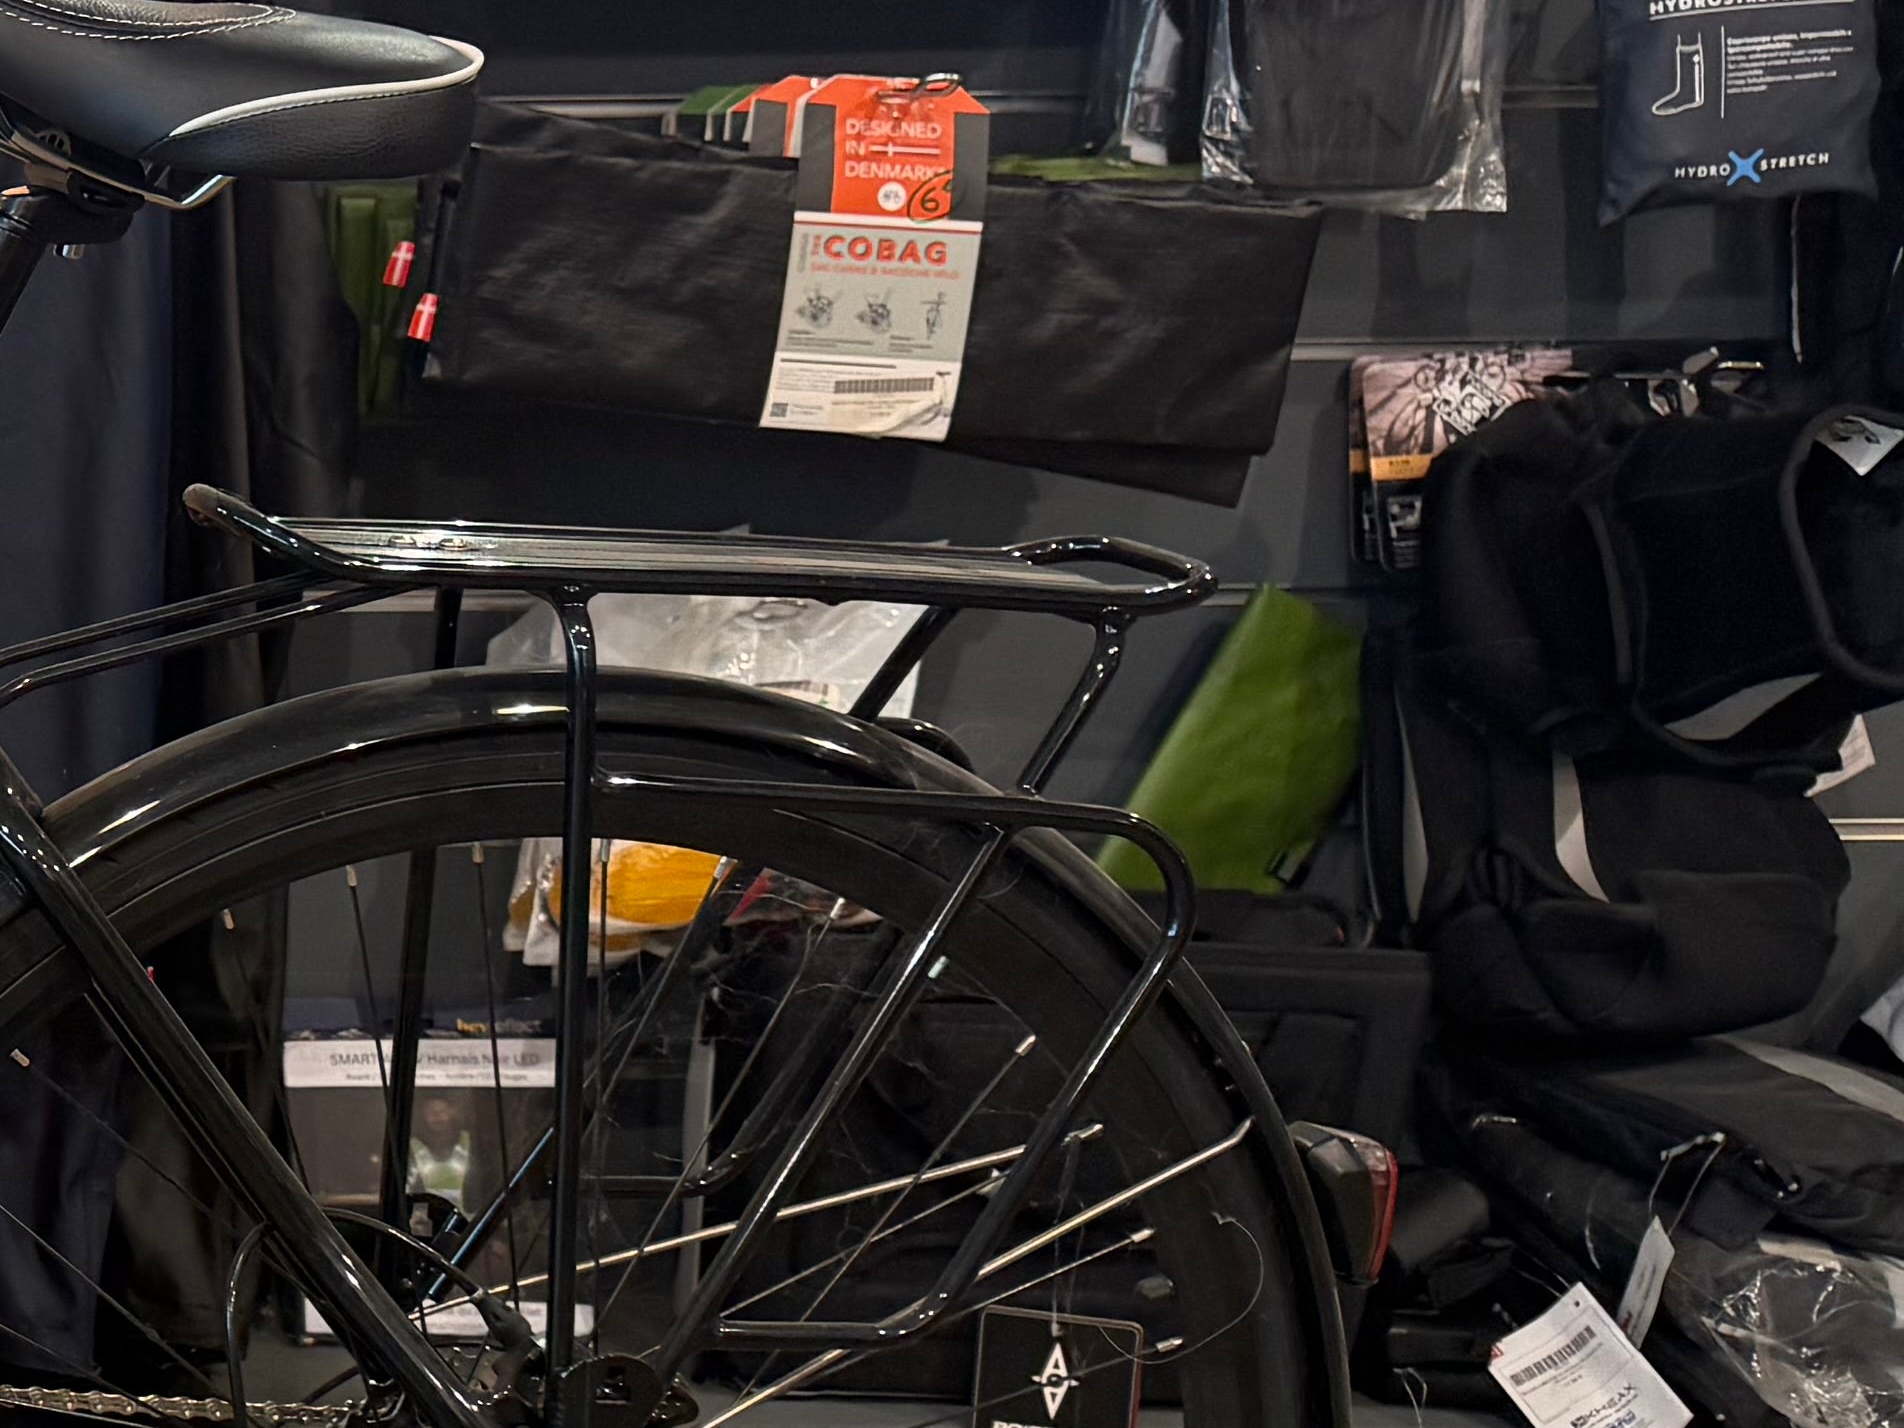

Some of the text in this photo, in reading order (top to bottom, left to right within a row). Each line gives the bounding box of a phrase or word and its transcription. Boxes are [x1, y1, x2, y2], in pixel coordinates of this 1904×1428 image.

[845, 118, 942, 138] DESIGNED
[846, 141, 865, 156] IN
[1675, 163, 1730, 178] HYDRO
[1760, 152, 1829, 172] STRETCH
[823, 234, 948, 267] COBAG
